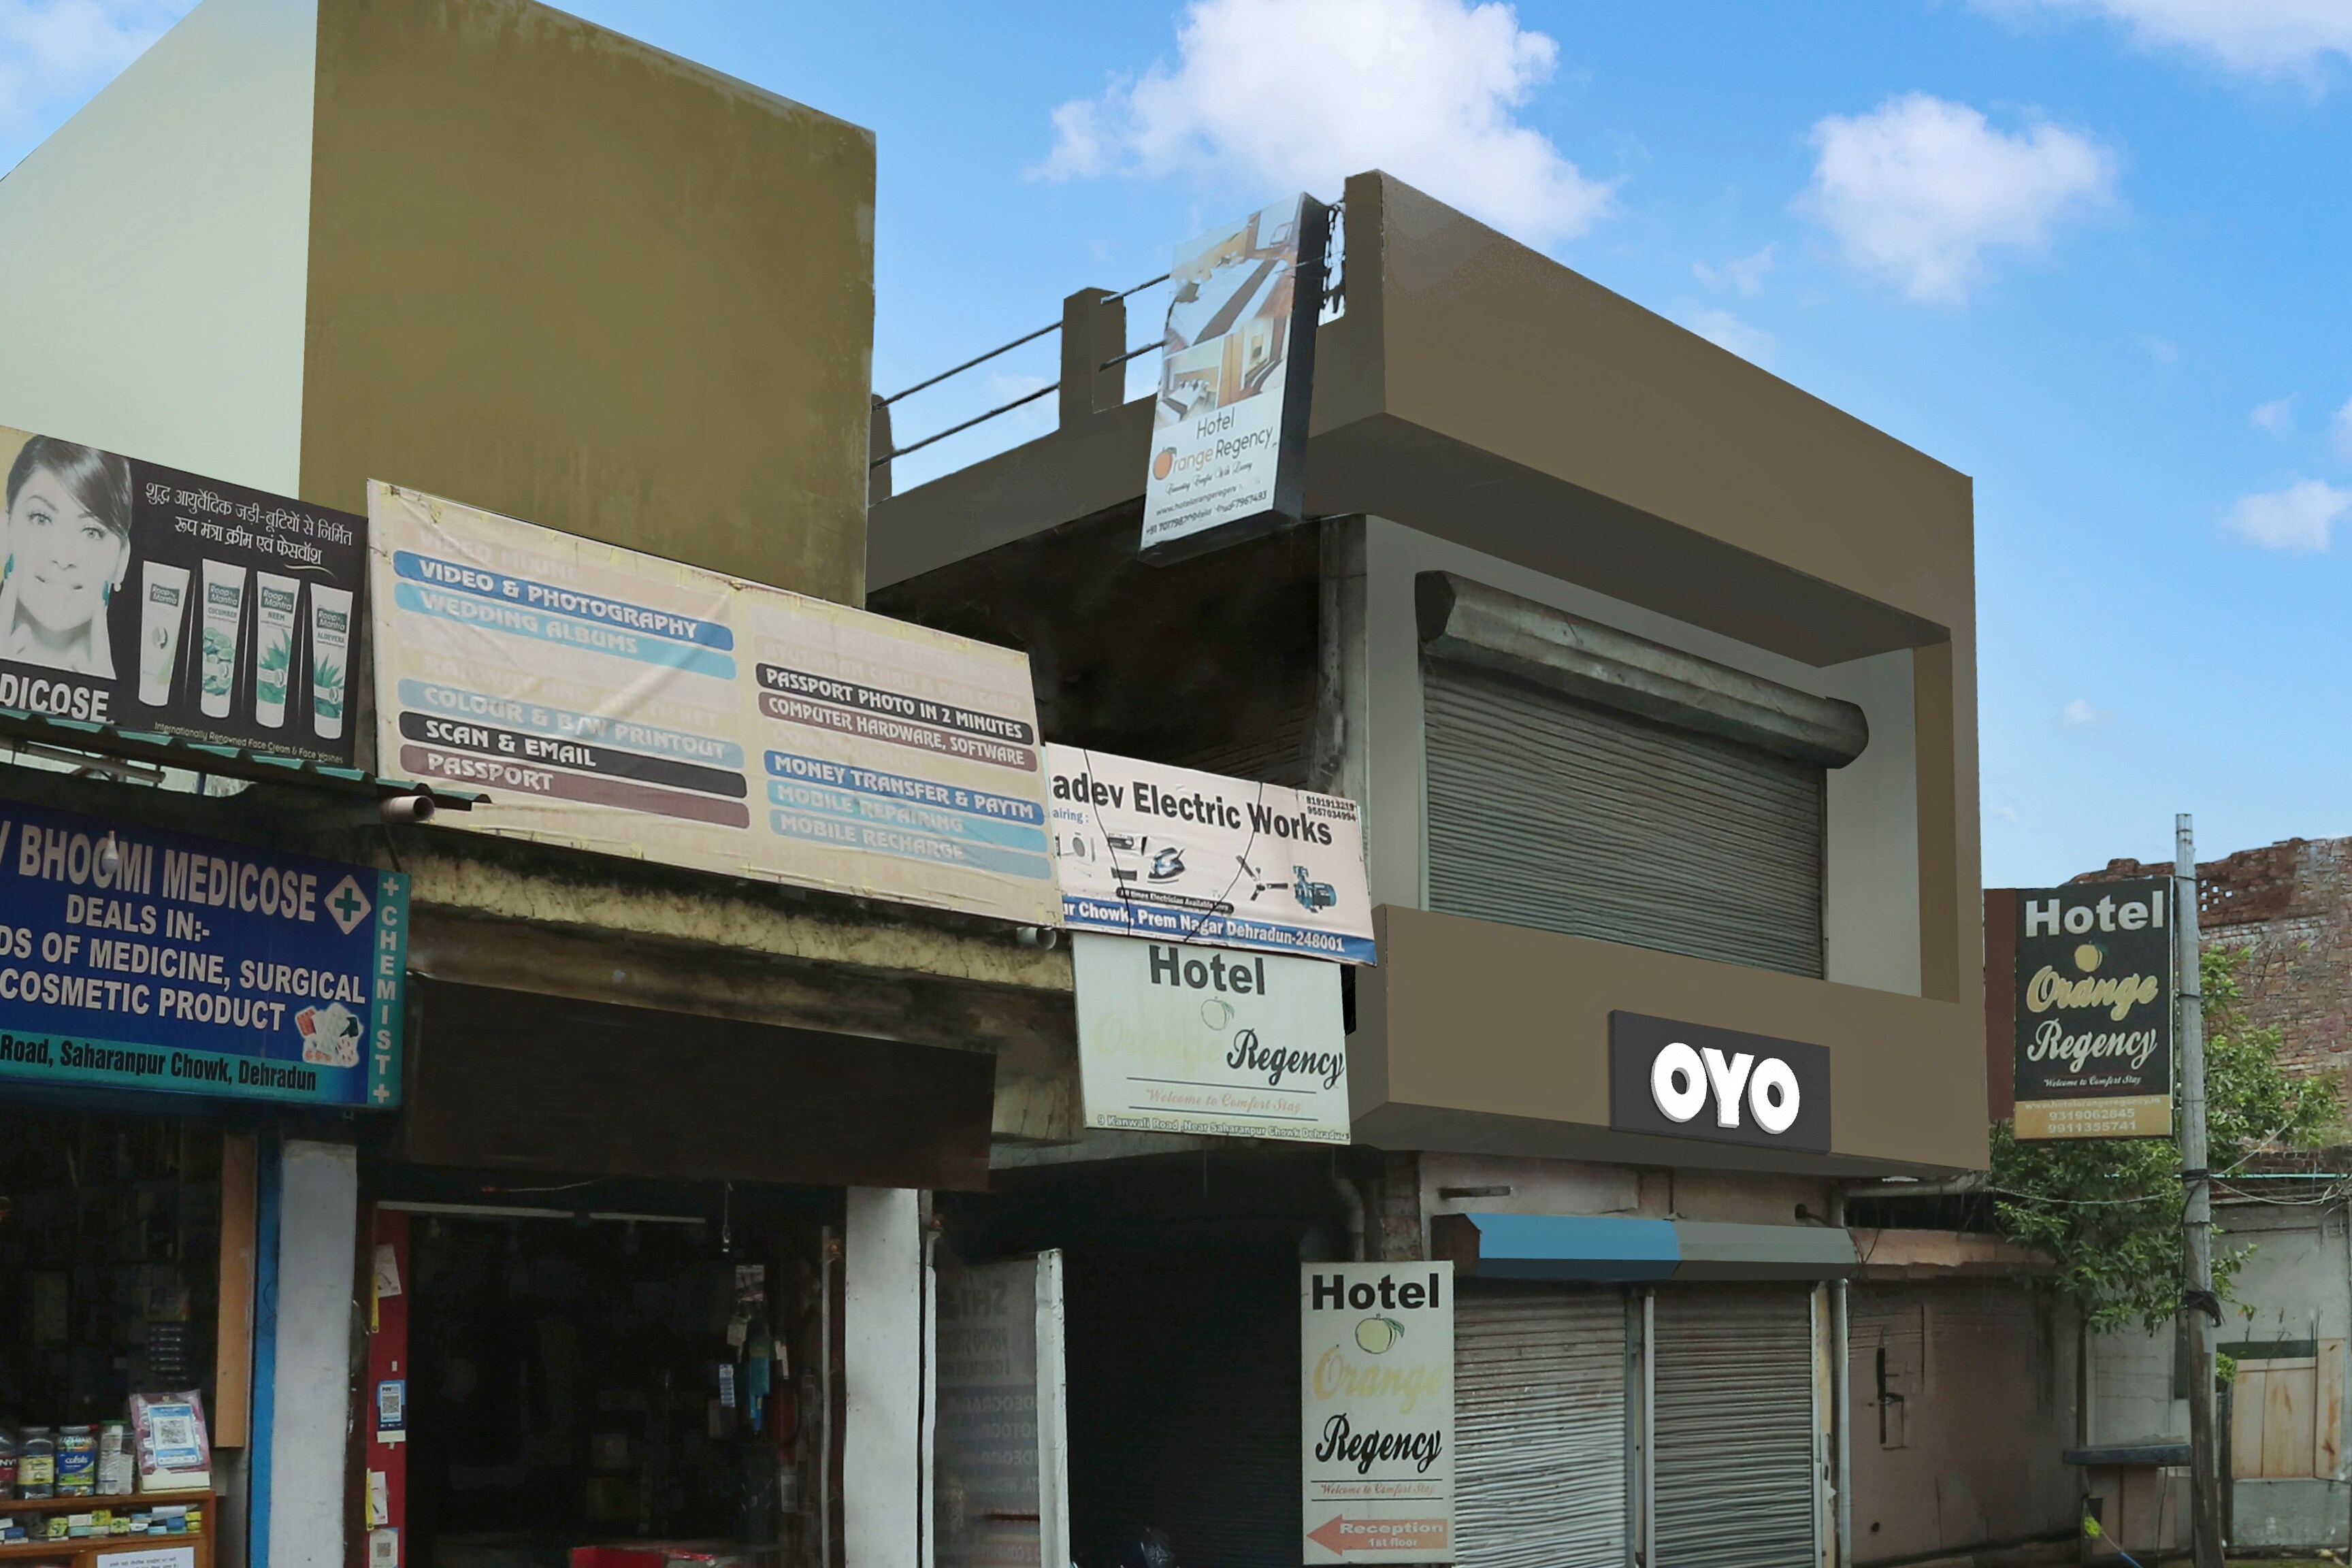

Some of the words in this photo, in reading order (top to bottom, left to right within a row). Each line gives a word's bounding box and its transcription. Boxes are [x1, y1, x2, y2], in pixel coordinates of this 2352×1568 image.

[1196, 407, 1235, 440] Hotel
[1215, 427, 1274, 459] Regency
[146, 483, 171, 505] शुद्ध
[174, 489, 232, 514] आयुर्वेदिक
[303, 514, 314, 536] से
[317, 519, 353, 546] निर्मित
[175, 516, 197, 536] रूप
[201, 519, 223, 542] मंत्रा
[225, 525, 252, 549] क्रीम
[256, 534, 274, 553] एवं
[210, 585, 229, 598] Roop
[210, 593, 238, 606] Mantra
[263, 590, 283, 602] Roop
[264, 599, 292, 611] Mantra
[419, 559, 494, 591] VIDEO
[503, 581, 519, 598] &
[527, 587, 698, 639] PHOTOGRAPHY
[268, 612, 285, 622] NEEM
[318, 611, 336, 623] Roop
[319, 619, 345, 632] Mantra
[420, 590, 538, 634] WEDDING
[546, 620, 638, 655] ALBUMS
[0, 672, 109, 722] DICOSE
[766, 667, 853, 701] PASSPORT
[858, 689, 915, 716] PHOTO
[920, 702, 937, 720] IN
[941, 708, 951, 723] 2
[956, 710, 1023, 739] MINUTES
[154, 722, 208, 741] Internationally
[209, 732, 246, 747] Renowned
[248, 740, 266, 750] Face
[267, 742, 291, 755] Cream
[299, 748, 316, 760] Face
[424, 688, 523, 723] COLOUR
[532, 708, 549, 726] &
[557, 713, 607, 738] B/W
[615, 722, 725, 759] PRINTOUT
[425, 720, 489, 748] SCAN
[498, 734, 516, 752] &
[525, 738, 597, 767] EMAIL
[768, 697, 853, 731] COMPUTER
[857, 716, 947, 750] HARDWARE,
[951, 736, 1025, 766] SOFTWARE
[427, 753, 555, 791] PASSPORT
[775, 755, 852, 784] MONEY
[851, 770, 950, 804] TRANSFER
[955, 791, 968, 805] &
[975, 796, 1033, 819] PAYTM
[778, 785, 855, 813] MOBILE
[860, 800, 964, 832] REPAIRING
[1053, 772, 1124, 808] adev
[1132, 781, 1241, 829] Electric
[1246, 802, 1333, 846] Works
[781, 814, 855, 841] MOBILE
[863, 829, 962, 860] RECHARGE
[18, 824, 153, 895] BHOOMI
[162, 849, 317, 922] MEDICOSE
[66, 894, 157, 934] DEALS
[165, 909, 210, 942] IN:-
[1150, 893, 1183, 904] Electrician
[2025, 890, 2163, 937] Hotel
[1079, 902, 1134, 926] Chowk,
[1137, 909, 1177, 928] Prem
[1180, 914, 1224, 936] Nagar
[1227, 921, 1345, 953] Dehradun-248001
[42, 932, 81, 964] OF
[89, 938, 231, 992] MEDICINE,
[239, 960, 366, 1004] SURGICAL
[375, 906, 397, 1075] CHEMIST
[1149, 944, 1266, 996] Hotel
[1, 968, 150, 1015] COSMETIC
[159, 987, 285, 1031] PRODUCT
[2026, 965, 2158, 1022] Orange
[1, 1034, 53, 1068] Road,
[60, 1040, 165, 1077] Saharanpur
[171, 1051, 232, 1085] Chowk,
[238, 1059, 316, 1092] Dehradun
[1094, 1012, 1222, 1079] Orange
[1227, 1028, 1345, 1090] Regency
[2027, 1017, 2157, 1073] Regency
[1146, 1089, 1201, 1105] Welcome
[1206, 1096, 1217, 1106] to
[1222, 1093, 1270, 1113] Comfort
[1273, 1098, 1301, 1114] Stay
[1650, 1042, 1800, 1134] OYO
[2044, 1077, 2077, 1088] Welcome
[2079, 1078, 2087, 1086] to
[2089, 1075, 2121, 1088] Comfort
[2122, 1075, 2142, 1085] Stay
[1097, 1114, 1105, 1126] 9
[1107, 1115, 1150, 1128] Kanwali
[1153, 1118, 1179, 1131] Road
[1210, 1123, 1266, 1138] Saharanpur
[1313, 1273, 1439, 1310] Hotel
[1313, 1344, 1445, 1416] Orange
[1315, 1412, 1442, 1475] Regency
[1321, 1483, 1361, 1495] Welcome
[1363, 1484, 1371, 1494] to
[1373, 1483, 1411, 1497] Comfort
[1413, 1483, 1435, 1496] Stay
[1339, 1522, 1443, 1536] Reception
[1369, 1537, 1388, 1547] 1st
[1390, 1537, 1418, 1547] floor
